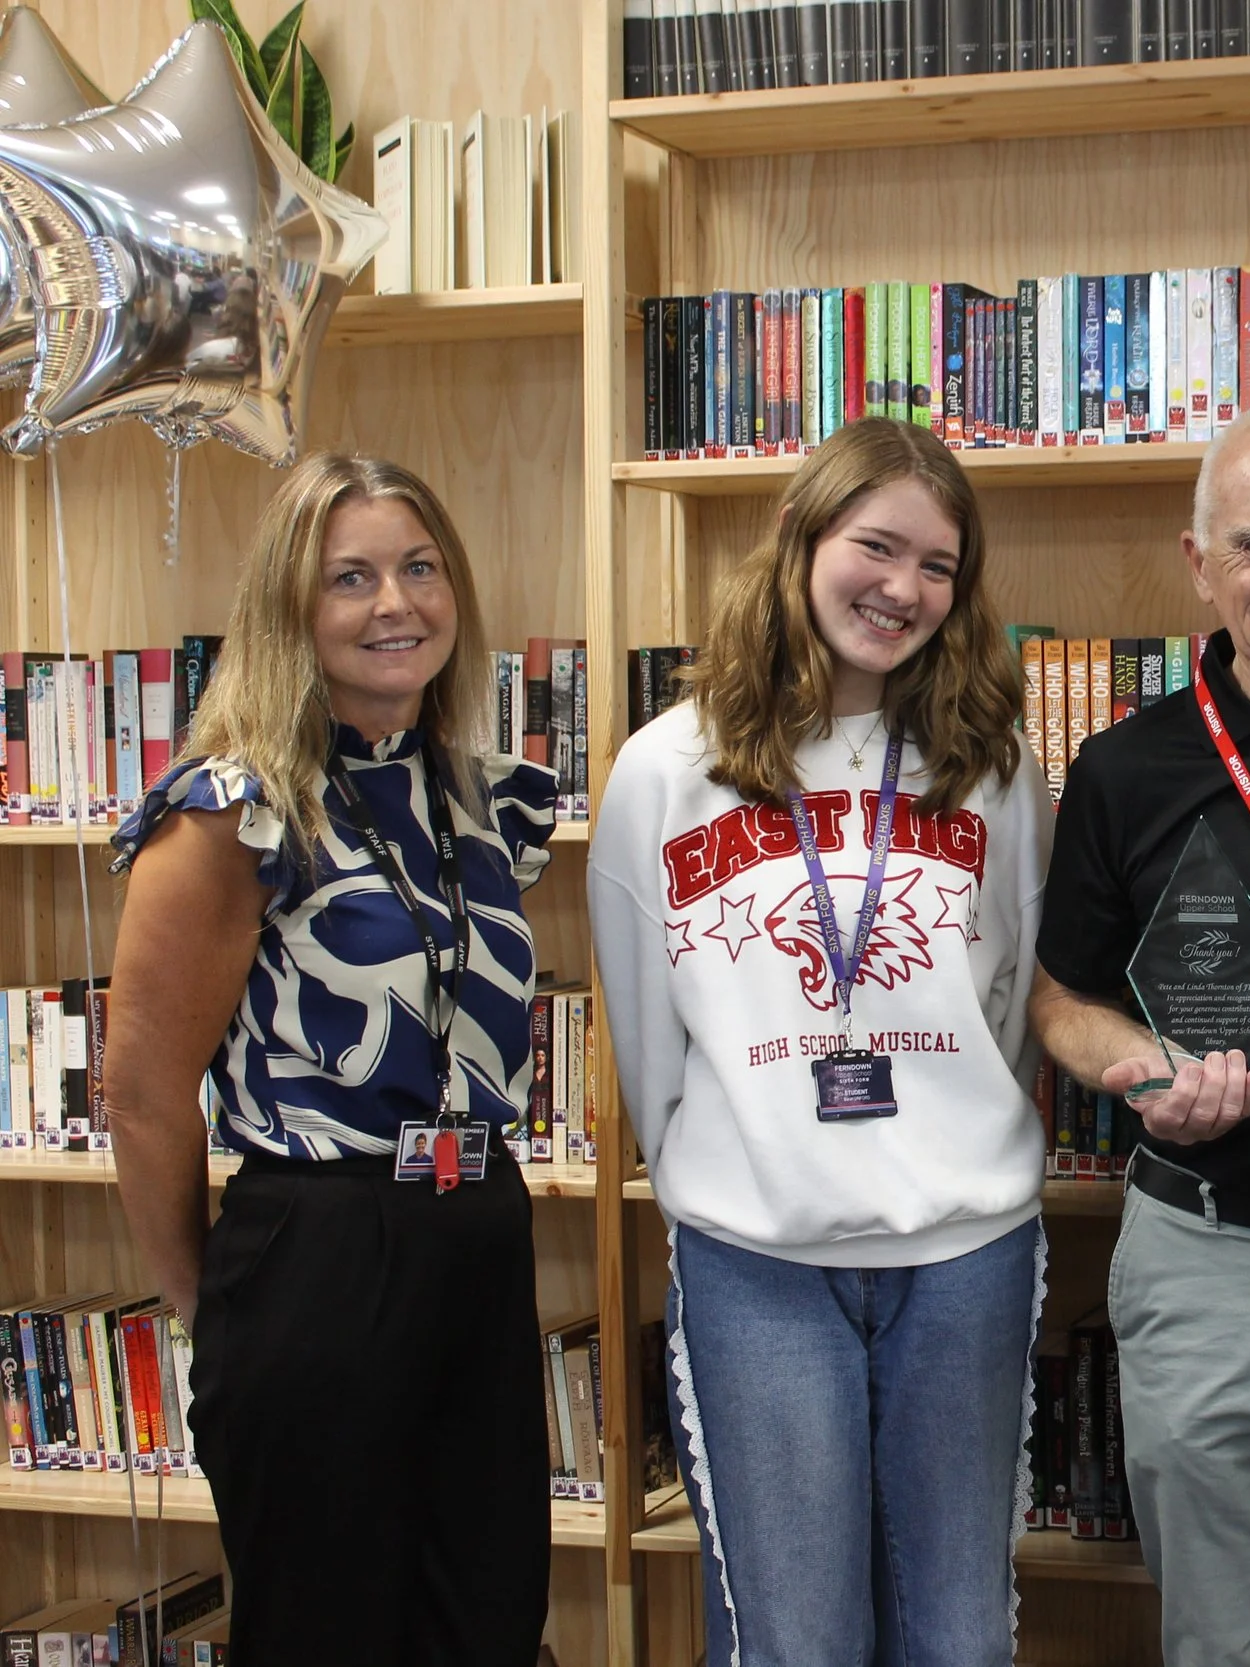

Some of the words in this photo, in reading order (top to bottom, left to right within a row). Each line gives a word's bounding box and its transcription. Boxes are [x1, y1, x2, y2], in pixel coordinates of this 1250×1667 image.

[1088, 282, 1096, 317] FAERIE
[869, 304, 879, 341] POISON
[892, 302, 903, 341] POISON
[915, 306, 926, 343] POISON
[1021, 316, 1033, 327] The
[892, 343, 903, 374] HEART
[1021, 329, 1033, 357] Darkest
[869, 345, 879, 376] HEART
[915, 348, 926, 378] HEART
[1021, 359, 1033, 375] Part
[718, 353, 726, 407] IMMORTAL
[946, 375, 963, 416] Zenith
[1021, 377, 1033, 385] of
[1022, 388, 1033, 399] the
[1021, 401, 1033, 424] Forest
[186, 660, 199, 696] Gideon
[642, 657, 651, 691] STEPHEN
[1024, 661, 1040, 698] WHO
[1046, 662, 1062, 698] WHO
[1070, 663, 1086, 698] WHO
[1092, 661, 1108, 697] WHO
[1115, 655, 1125, 696] HAND
[1126, 657, 1137, 694] IRON
[1142, 655, 1151, 696] TONGUE
[1151, 655, 1162, 696] SILVER
[575, 698, 585, 728] ARES
[643, 693, 651, 712] COLE
[1203, 701, 1222, 737] VISITOR
[1047, 718, 1062, 758] GODS
[885, 755, 898, 782] FORM
[792, 799, 806, 829] FORM
[876, 804, 890, 832] SIXTH
[365, 827, 387, 857] STAFF
[443, 831, 453, 860] STAFF
[663, 789, 851, 910] EAST
[800, 831, 817, 861] SIXTH
[873, 835, 886, 865] FORM
[816, 884, 831, 917] FORM
[863, 889, 878, 922] SIXTH
[1179, 895, 1234, 904] FERNDOWN
[1180, 904, 1205, 914] Upper
[1208, 903, 1236, 912] School
[425, 935, 438, 967] STAFF
[823, 920, 839, 953] SIXTH
[853, 925, 871, 957] FORM
[1179, 943, 1214, 960] Thank
[1216, 949, 1233, 961] you
[1175, 994, 1213, 1003] appreciation
[1235, 983, 1244, 992] of
[94, 1000, 100, 1010] MY
[1168, 1005, 1178, 1014] for
[1215, 1017, 1238, 1025] support
[1239, 1016, 1247, 1025] of
[572, 1017, 581, 1050] Judith
[1205, 1037, 1226, 1045] library.
[1220, 1028, 1238, 1036] Upper
[748, 1036, 790, 1067] HIGH
[868, 1032, 960, 1054] MUSICAL
[99, 1360, 107, 1384] MAURIER
[1106, 1352, 1117, 1372] The
[103, 1390, 108, 1398] MY
[1105, 1375, 1117, 1438] Maleficent
[1105, 1440, 1117, 1477] Seven
